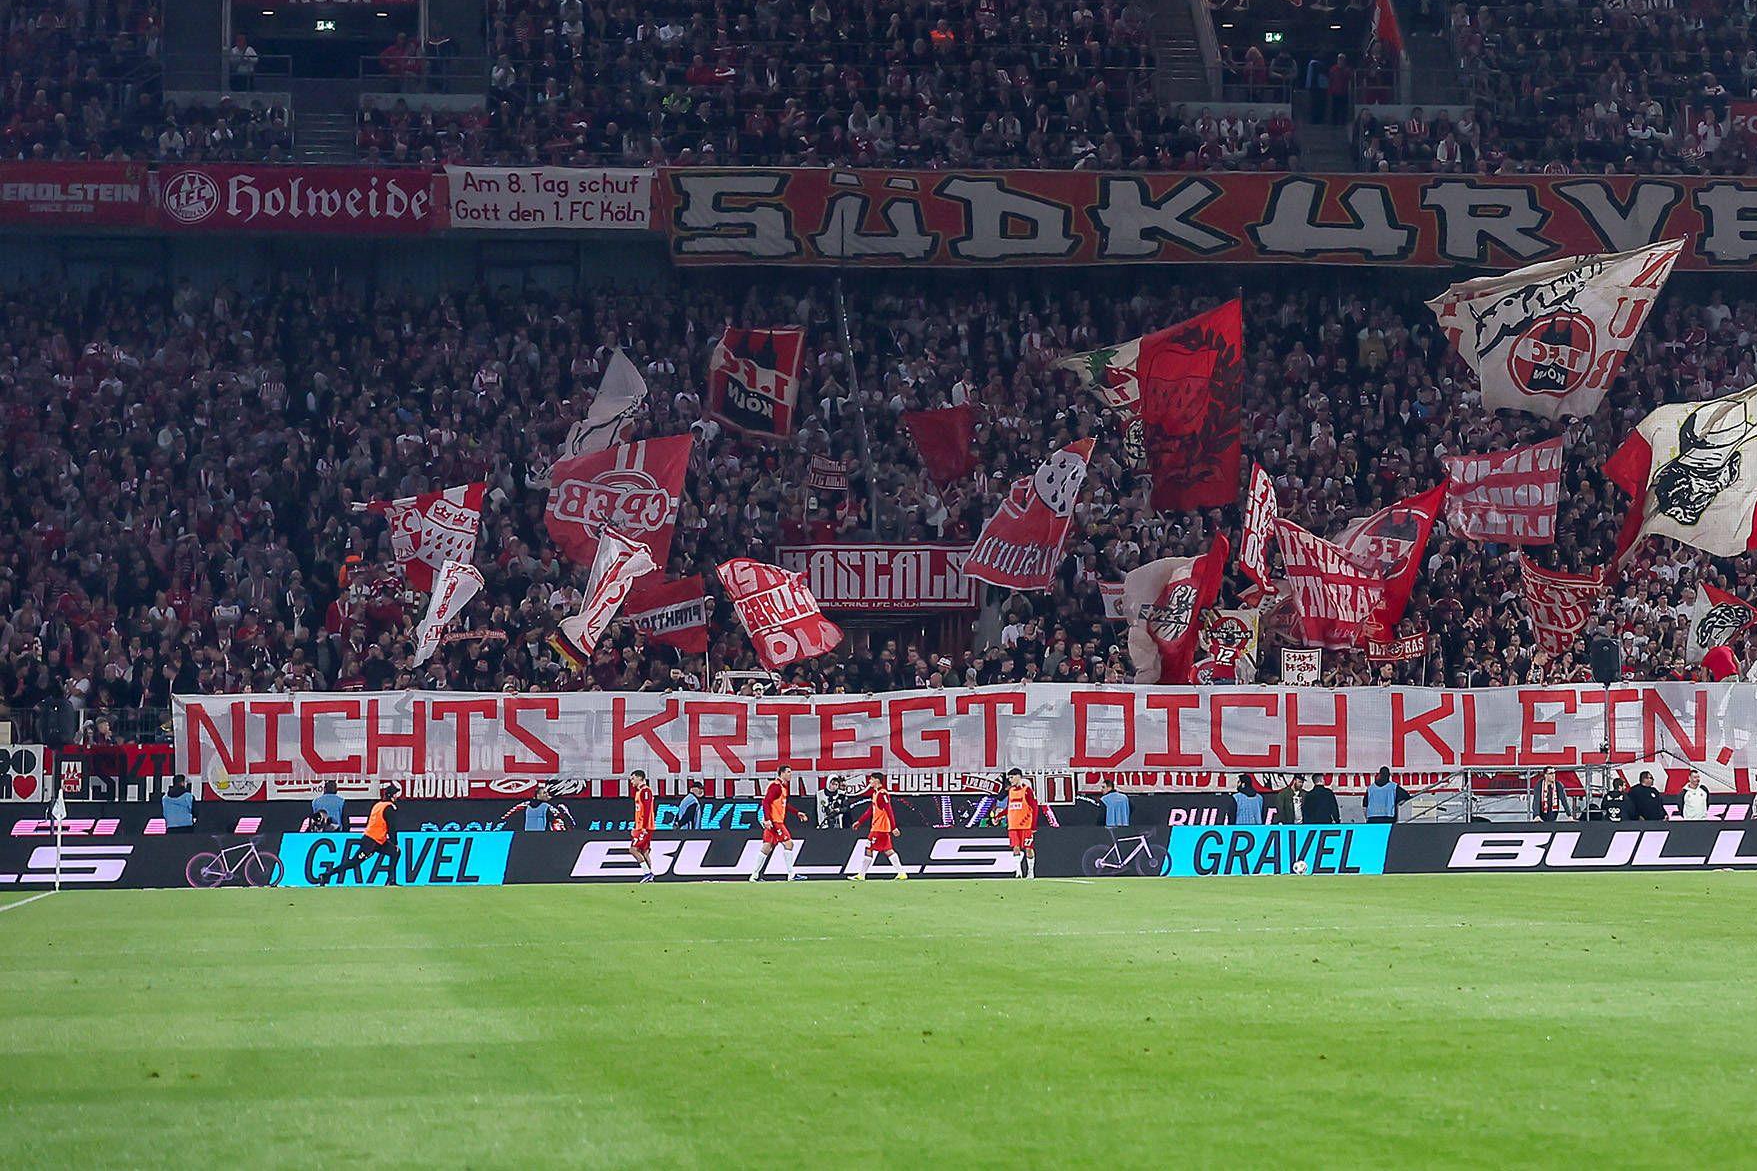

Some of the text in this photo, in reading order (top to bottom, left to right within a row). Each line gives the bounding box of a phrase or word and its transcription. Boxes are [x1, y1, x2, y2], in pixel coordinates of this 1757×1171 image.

[226, 174, 430, 224] Holweide
[463, 172, 639, 198] Am 8. Tag schuf
[456, 200, 500, 220] Gott
[508, 202, 544, 221] den
[600, 201, 644, 221] Köln
[185, 698, 560, 775] NICHTS
[611, 691, 1026, 773] KRIEGT
[1070, 690, 1347, 768] DICH
[1391, 689, 1734, 767] KLEIN,
[304, 837, 481, 885] GRAVEL
[569, 838, 1024, 878] BULLS
[1193, 829, 1361, 875] GRAVEL
